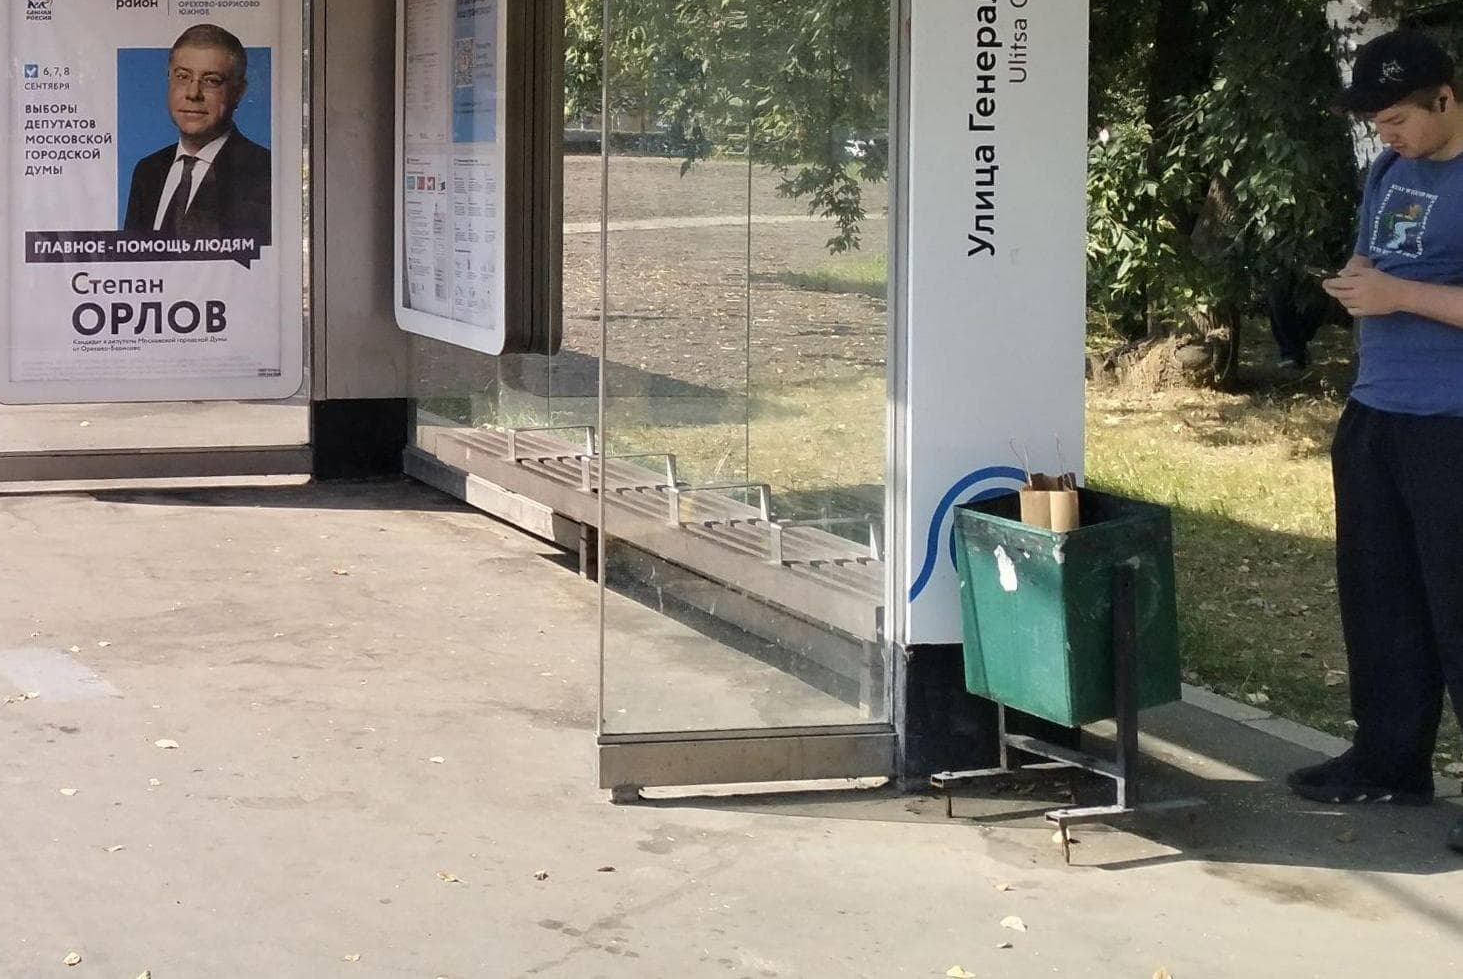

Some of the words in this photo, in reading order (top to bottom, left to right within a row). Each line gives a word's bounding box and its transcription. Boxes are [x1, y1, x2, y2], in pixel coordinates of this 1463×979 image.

[1008, 19, 1027, 83] Ulitsa
[63, 67, 70, 76] 8
[24, 82, 70, 91] СЕНТЯБРЯ
[25, 104, 78, 114] ВЫБОРЫ
[24, 119, 96, 131] ДЕПУТАТОВ
[25, 132, 112, 144] МОСКОВСКОЙ
[25, 147, 101, 161] ГОРОДСКОЙ
[24, 165, 63, 176] ДУМЫ
[968, 146, 998, 256] Улица
[34, 240, 106, 254] ГЛАВНОЕ
[116, 239, 191, 255] ПОМОЩЬ
[193, 238, 255, 253] ЛЮДЯМ
[71, 271, 164, 294] Степан
[71, 299, 227, 336] ОРЛОВ
